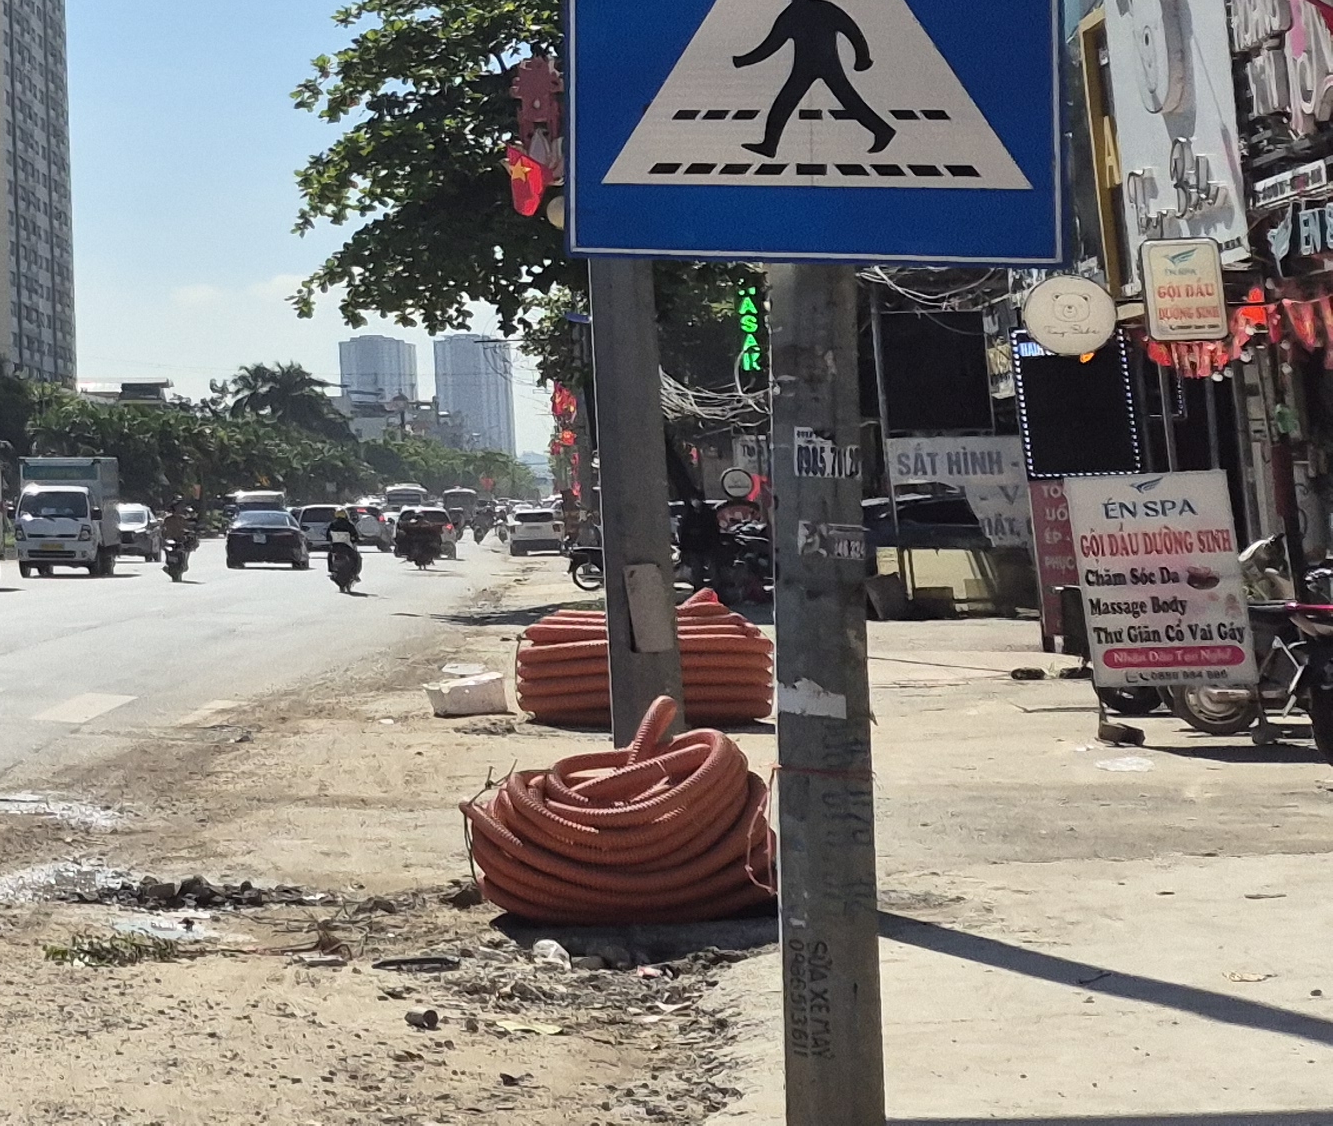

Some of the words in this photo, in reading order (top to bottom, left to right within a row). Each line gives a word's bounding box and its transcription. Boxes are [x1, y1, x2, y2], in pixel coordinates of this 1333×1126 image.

[946, 446, 1005, 476] HÌNH
[1102, 497, 1138, 520] ÉN
[1144, 498, 1199, 518] SPA
[1197, 528, 1234, 554] SINH
[1085, 568, 1127, 587] Chăm
[1130, 566, 1156, 586] Sóc
[1158, 566, 1180, 585] Da
[1088, 597, 1148, 619] Massage
[1150, 595, 1187, 617] Body
[1093, 626, 1125, 645] Thư
[1127, 623, 1162, 643] Giãn
[1165, 618, 1185, 642] Cổ
[1187, 623, 1214, 641] Vai
[1217, 621, 1246, 644] Gáy
